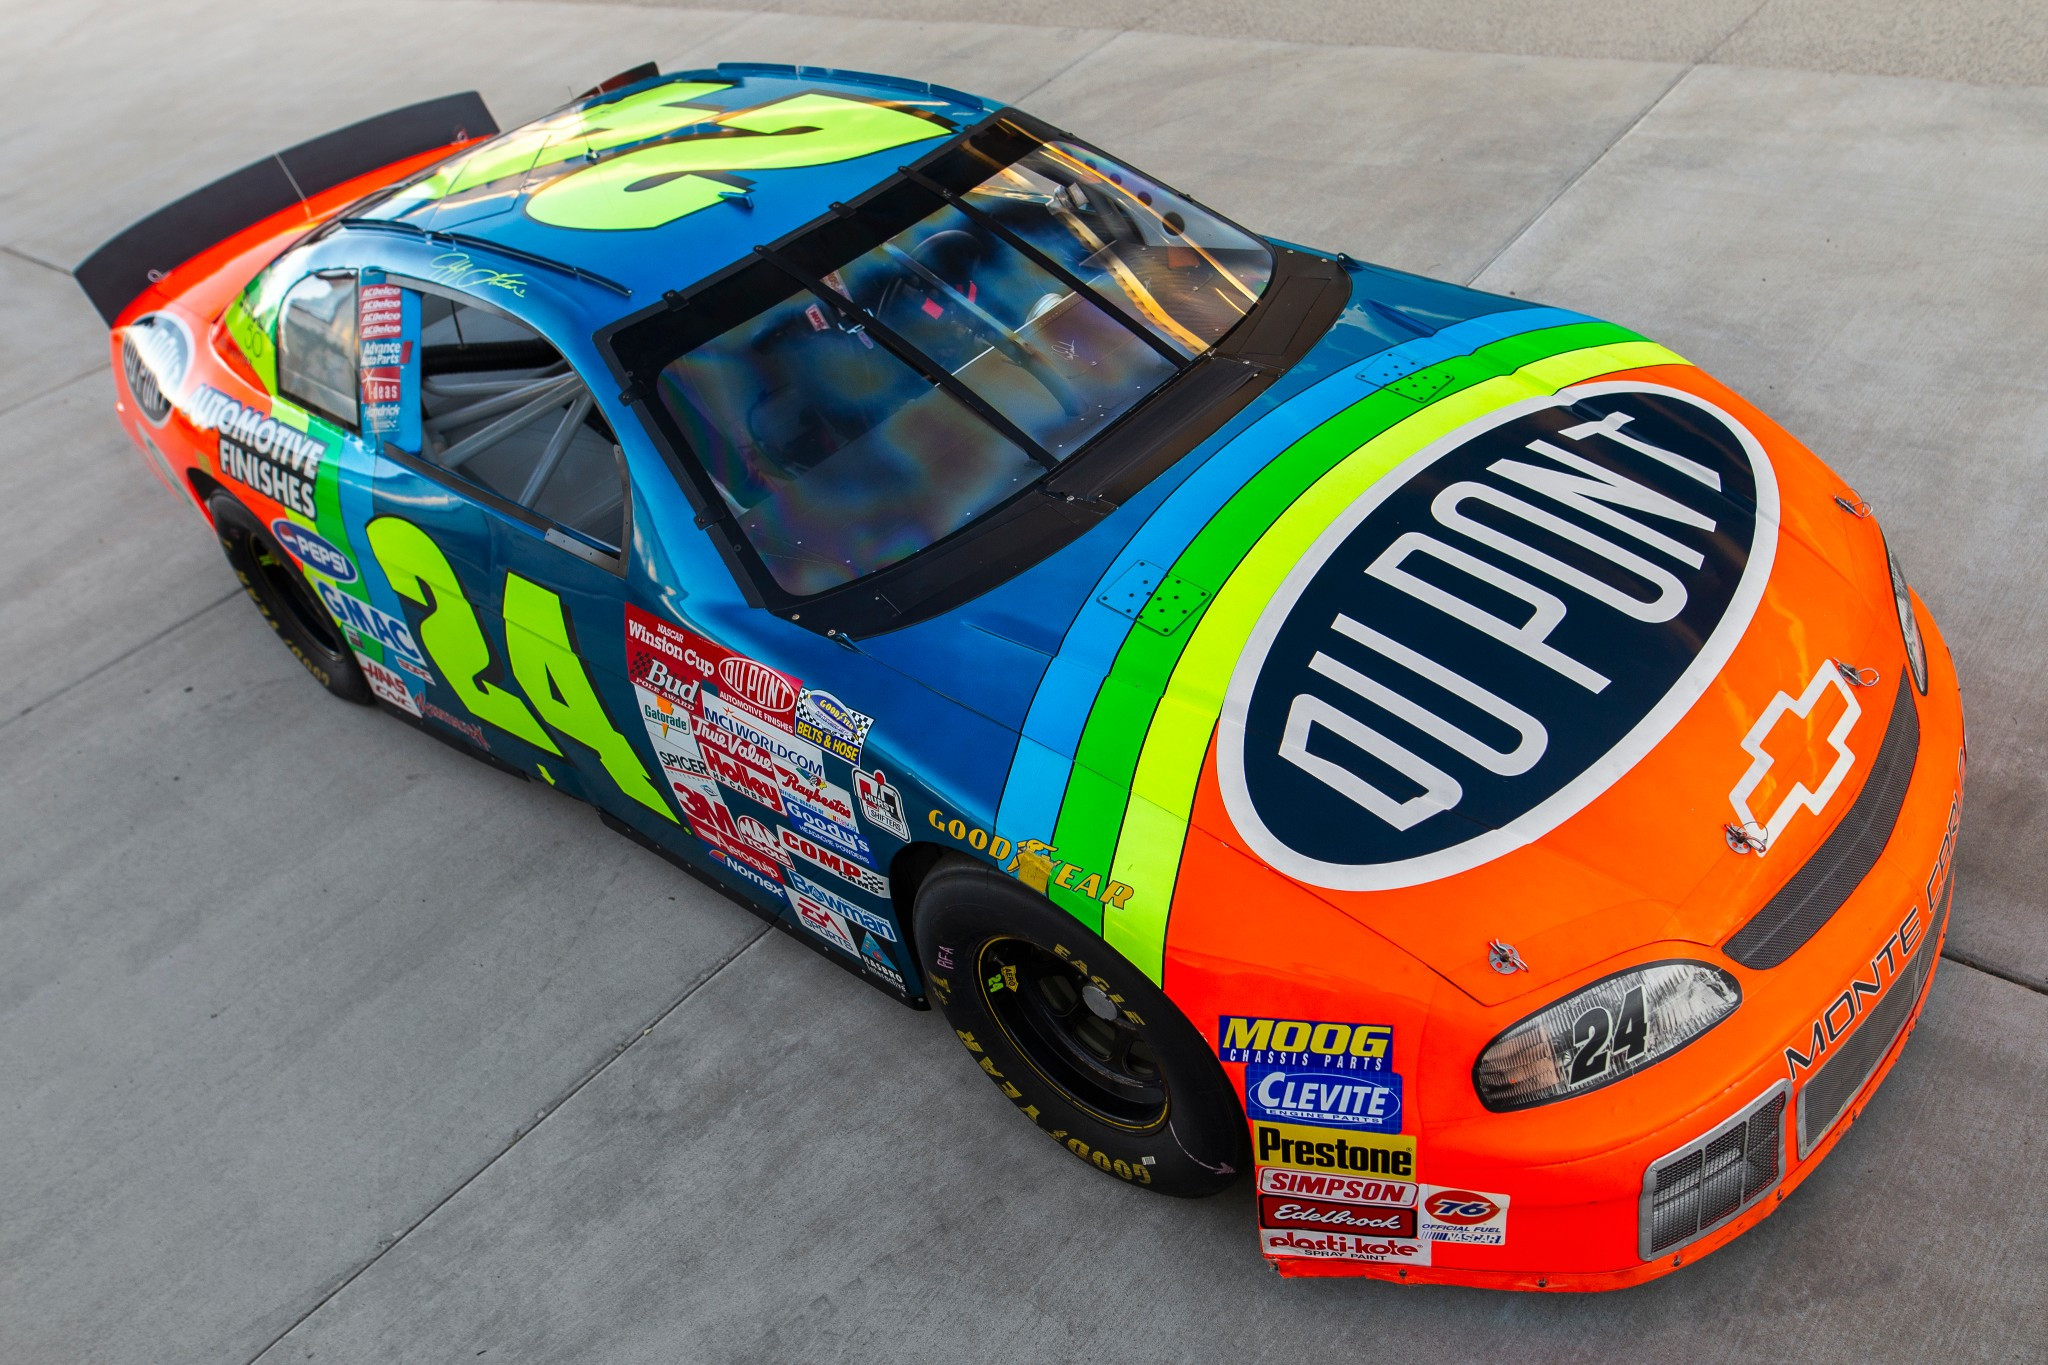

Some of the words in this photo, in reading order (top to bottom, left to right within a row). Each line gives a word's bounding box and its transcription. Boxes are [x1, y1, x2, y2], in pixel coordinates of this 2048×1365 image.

[364, 341, 400, 355] Advance
[184, 384, 327, 480] AUTOMOTIVE
[220, 439, 317, 520] FINISHES
[296, 535, 349, 577] PEPSI
[317, 579, 420, 661] GMAC
[657, 623, 683, 643] NASCAR
[629, 619, 683, 661] Winston
[685, 649, 714, 677] Cup
[361, 661, 406, 696] HAAS
[365, 513, 682, 826] 24
[646, 659, 699, 704] Bud
[636, 677, 660, 693] POLE
[662, 692, 694, 711] AWARD
[720, 691, 762, 718] AUTOMOTIVE
[764, 713, 793, 733] FINISHES
[645, 704, 687, 731] Gatorade
[704, 706, 734, 733] MCI
[735, 722, 823, 778] WORLDCOM
[797, 721, 823, 744] BELTS
[823, 734, 832, 749] &
[832, 739, 859, 762] HOSE
[659, 751, 710, 775] SPICER
[702, 745, 782, 811] Holley
[713, 772, 725, 782] HP
[729, 781, 765, 803] CARBS
[777, 764, 851, 819] Raybestos
[864, 792, 894, 814] HURST
[673, 782, 741, 841] 3M
[786, 801, 870, 853] Goody's
[870, 809, 902, 830] SHIFTERS
[716, 830, 779, 879] Aeroquip
[740, 819, 784, 855] MAC
[745, 836, 791, 867] TOOLS
[782, 831, 862, 878] COMP
[726, 854, 784, 897] Nomex
[838, 871, 880, 894] CAMS
[793, 872, 895, 941] Bowman
[798, 896, 849, 941] EA
[802, 916, 853, 952] SPORTS
[862, 954, 903, 983] HASBRO
[988, 973, 1004, 993] 24
[1006, 968, 1016, 987] AERO
[1054, 943, 1146, 1026] EAGLE
[1783, 907, 1922, 1081] MONTE
[1222, 1018, 1391, 1058] MOOG
[1567, 984, 1649, 1088] 24
[1230, 1048, 1309, 1066] CHASSIS
[1324, 1055, 1382, 1071] PARTS
[1257, 1071, 1391, 1116] CLEVITE
[1269, 1109, 1320, 1119] ENGINE
[1332, 1114, 1381, 1123] PARTS
[1258, 1126, 1412, 1177] Prestone
[1270, 1172, 1405, 1202] SIMPSON
[1273, 1204, 1401, 1230] Edelbrock
[1433, 1198, 1491, 1218] 76
[1269, 1231, 1418, 1257] plasti-kote
[1421, 1223, 1469, 1232] OFFICIAL
[1447, 1232, 1501, 1244] NASCAR
[1304, 1249, 1345, 1258] SPRAY
[1350, 1252, 1387, 1261] PAINT
